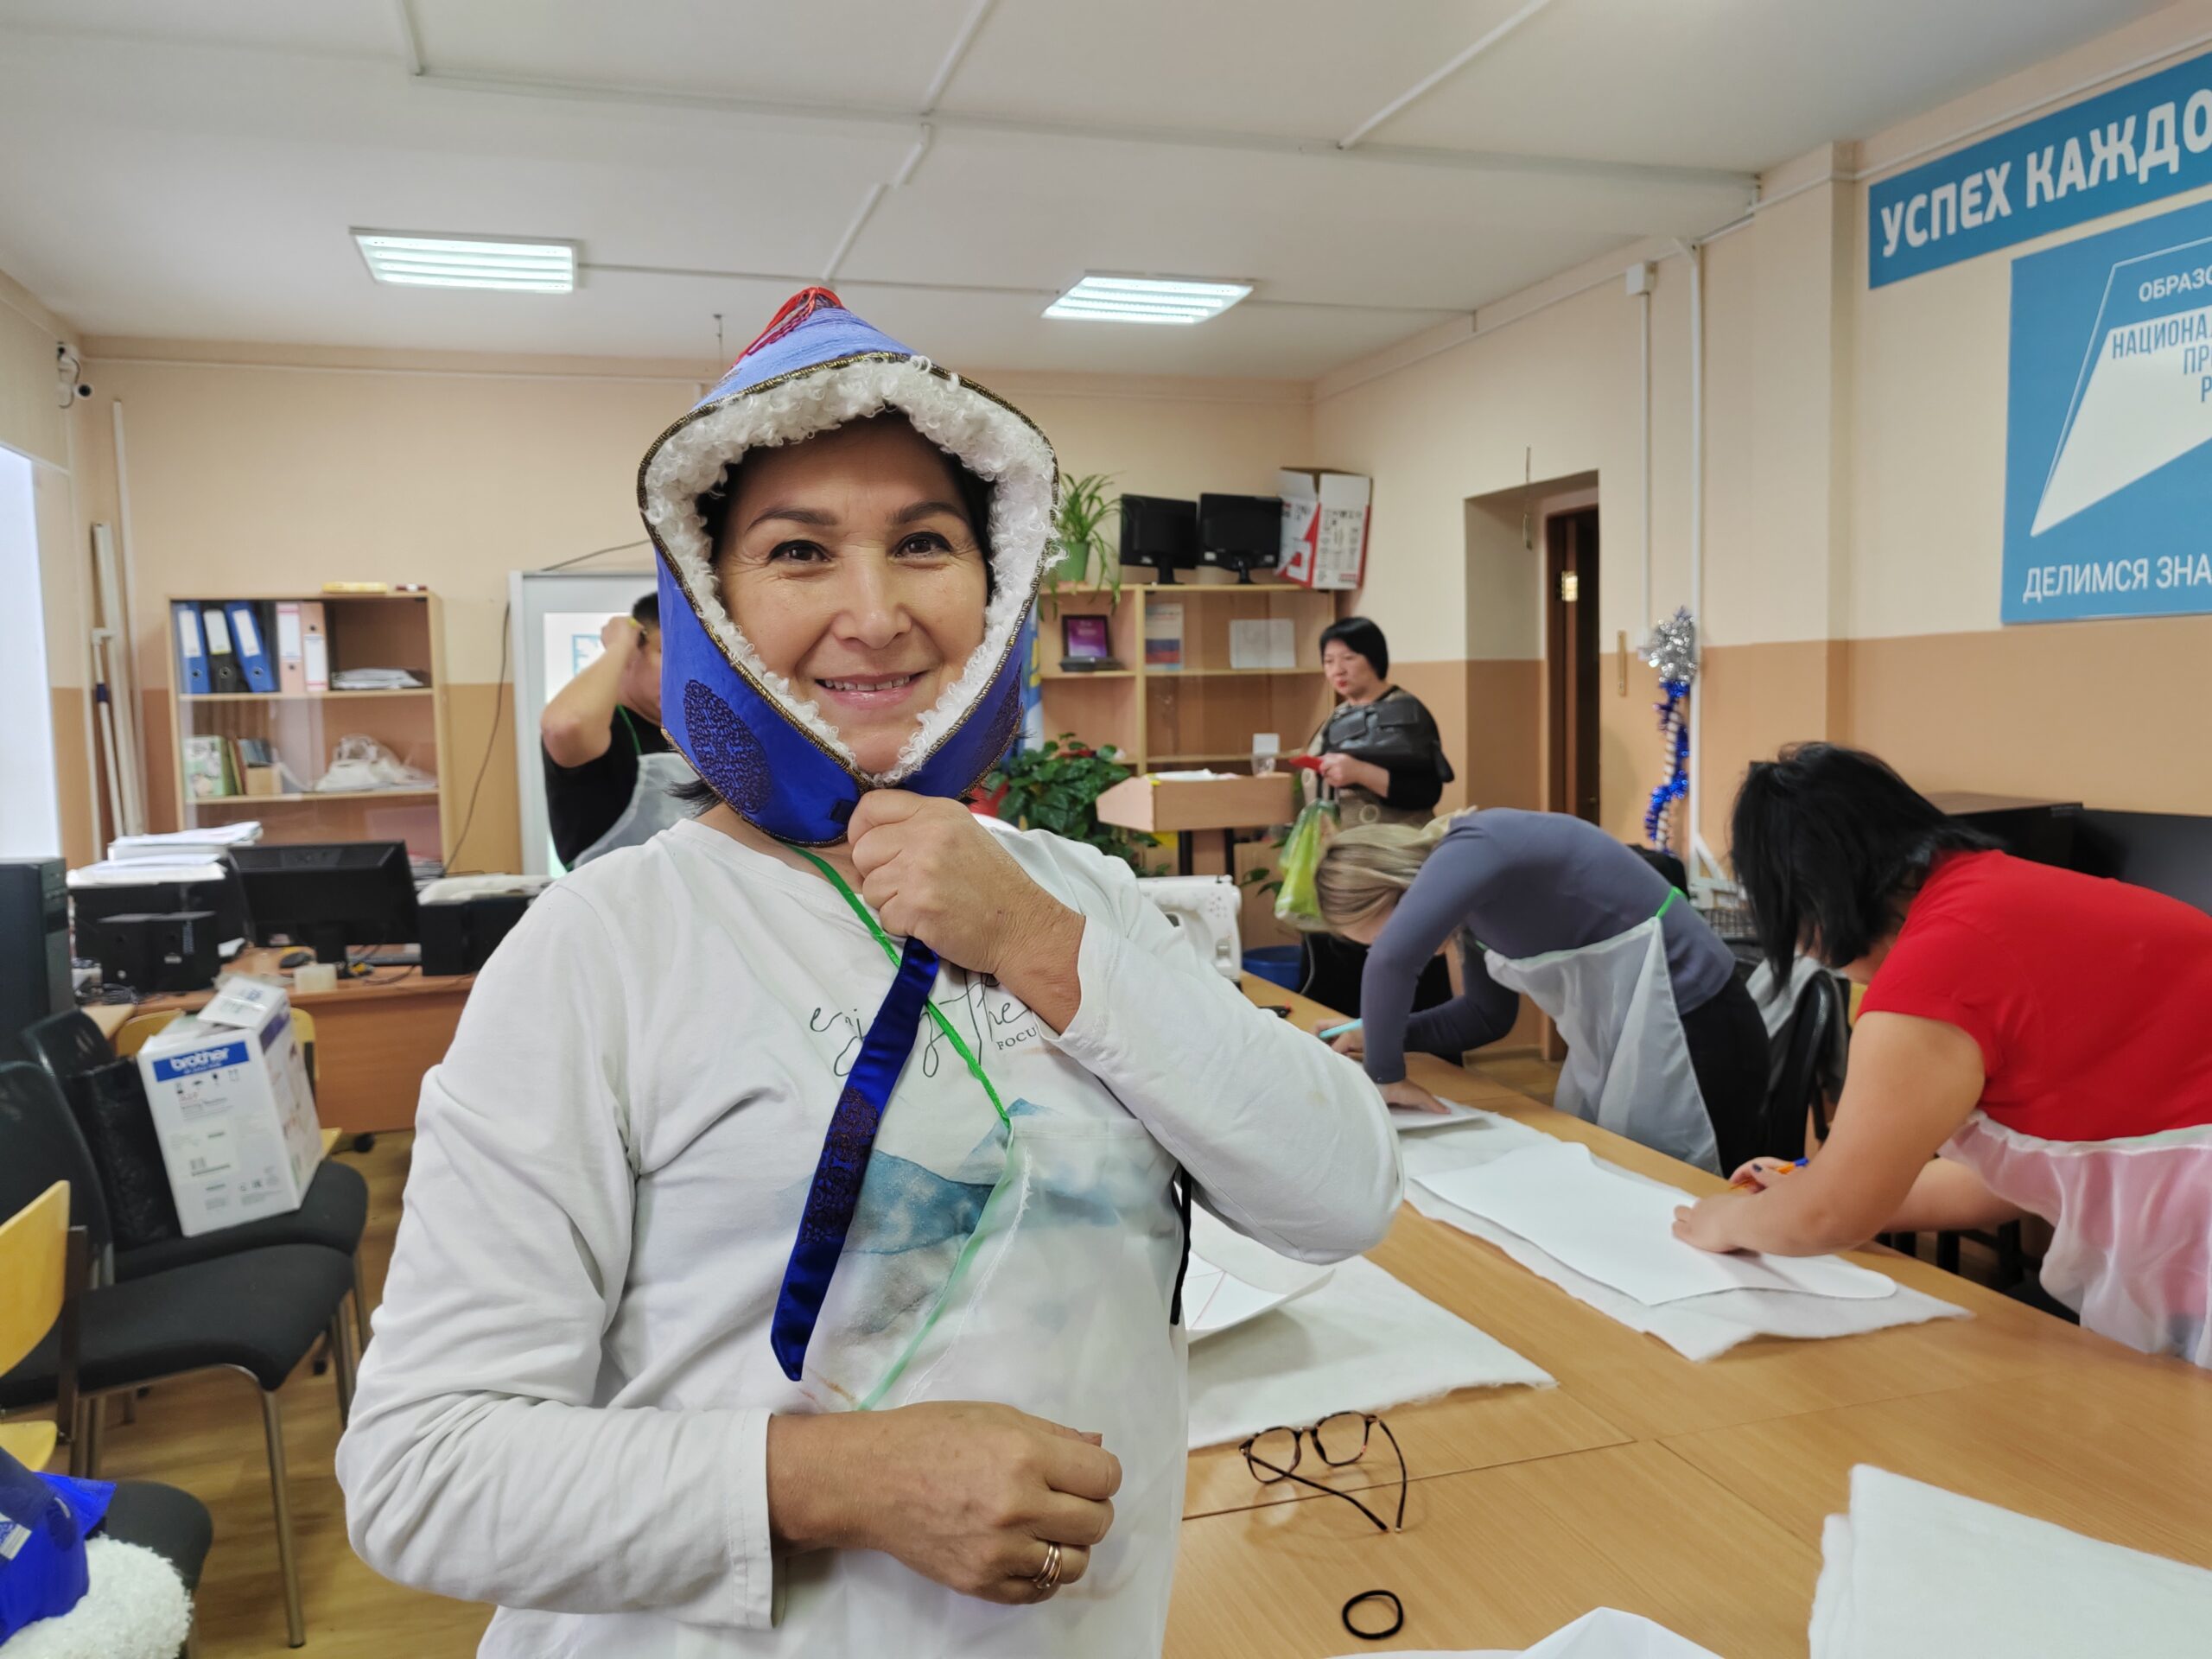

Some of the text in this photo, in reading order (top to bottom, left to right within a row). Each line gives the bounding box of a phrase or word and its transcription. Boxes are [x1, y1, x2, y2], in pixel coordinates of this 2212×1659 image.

[1880, 88, 2212, 257] УСПЕХ КАЖДО
[2113, 312, 2212, 359] НАЦИОНА
[2183, 346, 2212, 375] ПР
[2022, 552, 2212, 603] ДЕЛИМСЯ ЗНА
[169, 1046, 230, 1071] brother
[810, 1007, 947, 1077] enjy
[996, 1027, 1037, 1051] FOCU
